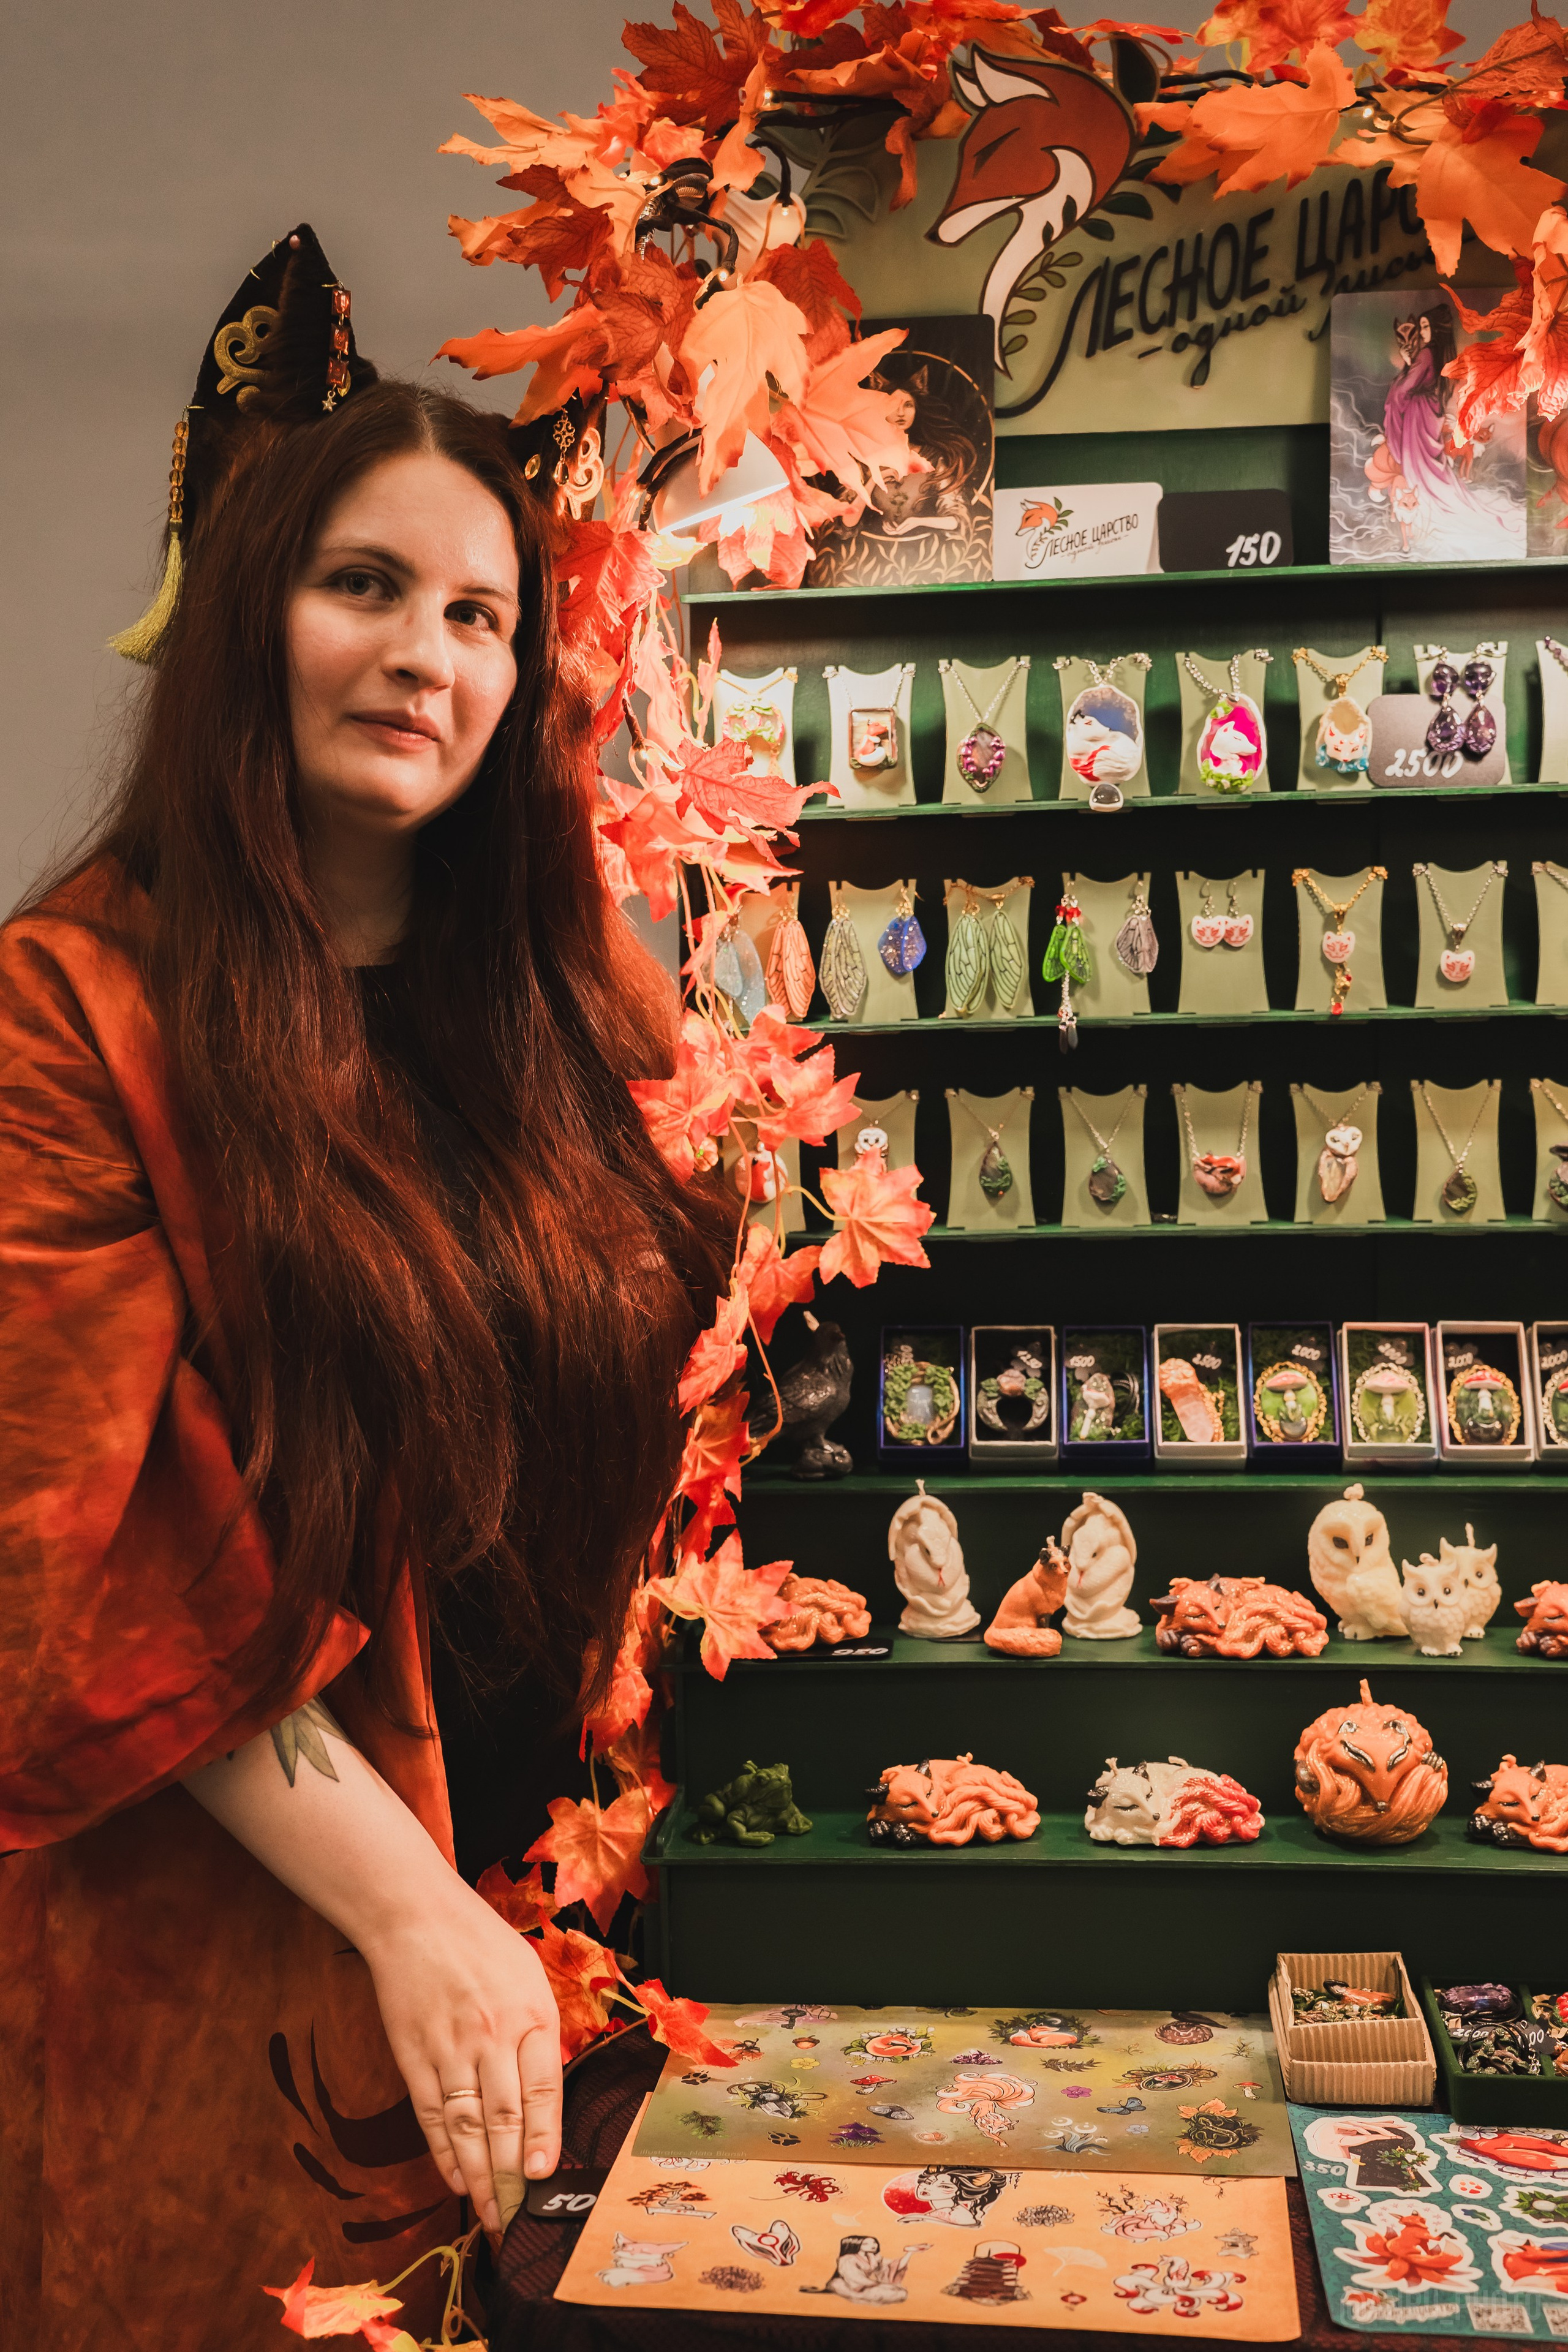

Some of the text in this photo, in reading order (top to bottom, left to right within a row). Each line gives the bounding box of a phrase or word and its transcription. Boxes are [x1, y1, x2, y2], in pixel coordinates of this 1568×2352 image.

[995, 207, 1275, 418] ЛЕСНОЕ
[1171, 285, 1307, 389] одной
[1025, 513, 1139, 569] ЛЕСНОЕ ЦАРСТВО
[1226, 530, 1282, 567] 150
[1384, 748, 1464, 778] 2500
[1291, 1343, 1321, 1361] 2000
[831, 1647, 889, 1656] 950
[1302, 2160, 1346, 2176] 350
